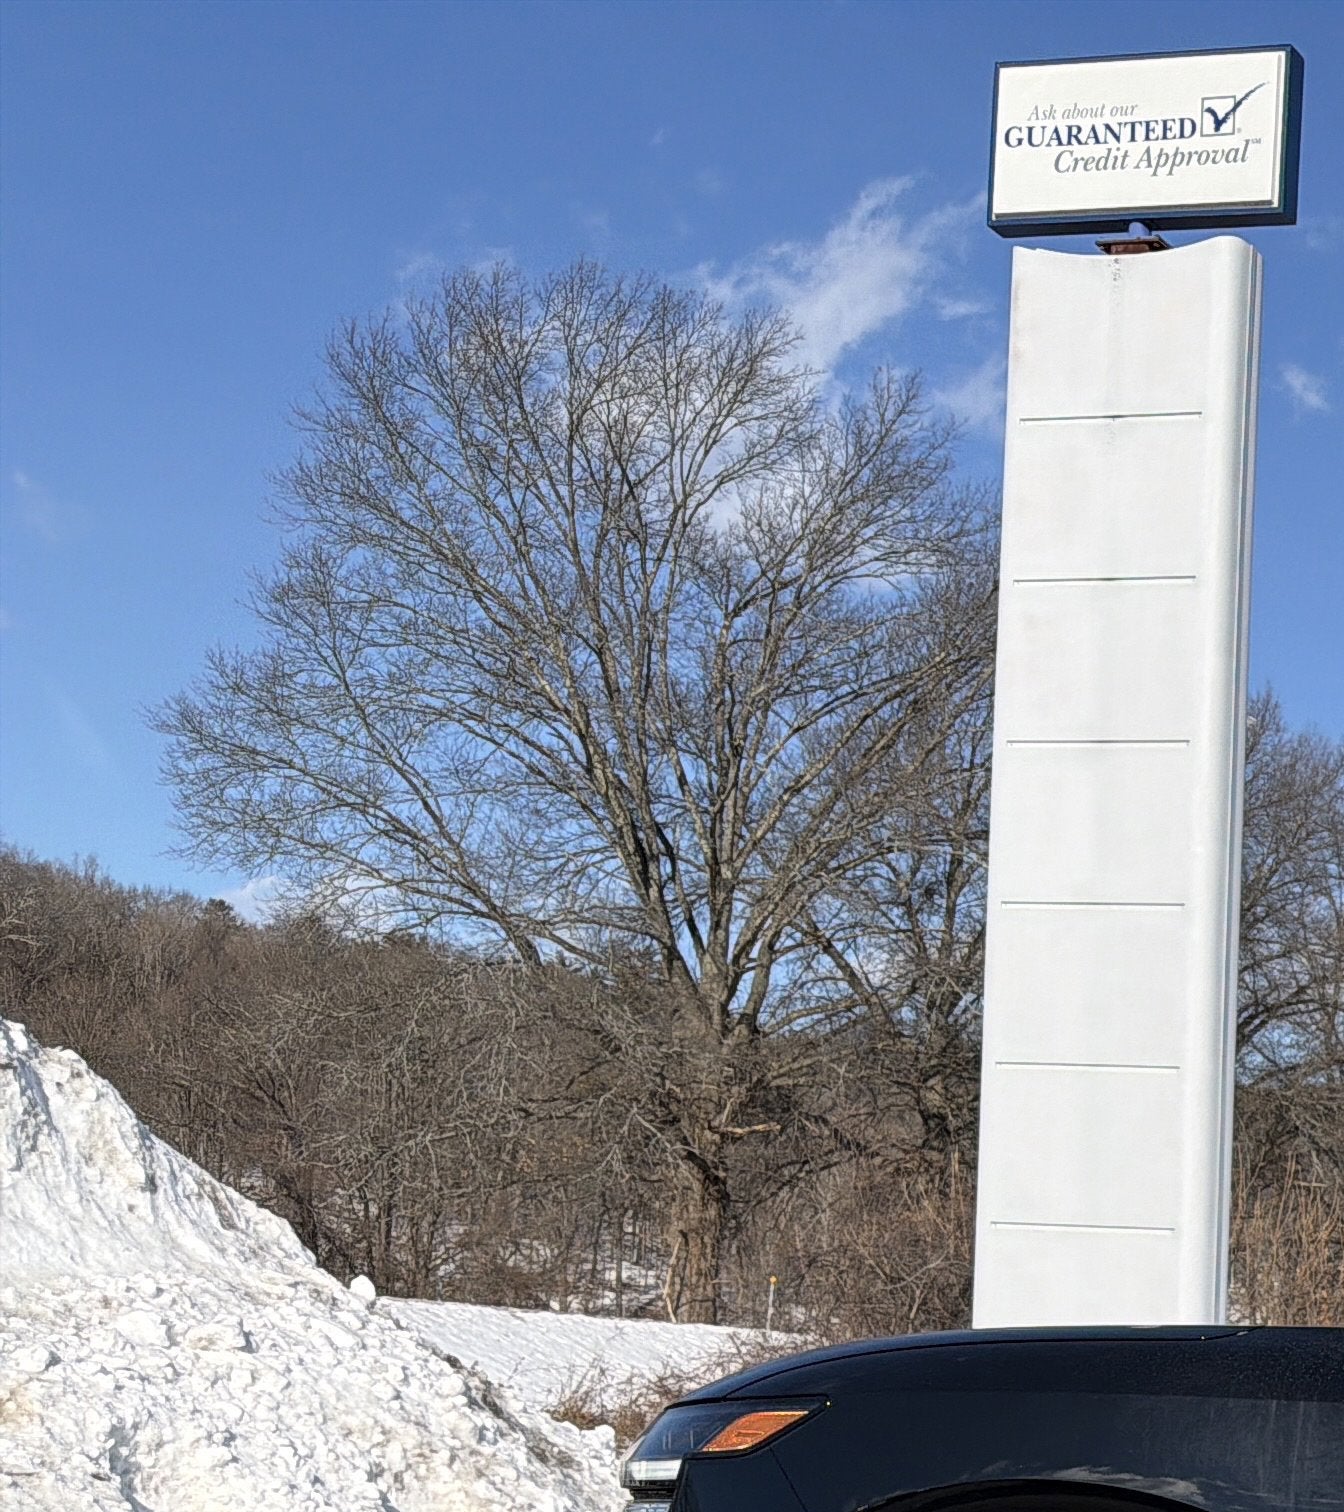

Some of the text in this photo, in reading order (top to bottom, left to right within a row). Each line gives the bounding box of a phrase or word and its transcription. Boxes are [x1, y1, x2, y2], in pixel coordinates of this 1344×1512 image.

[1028, 102, 1138, 121] Ask about our
[1004, 117, 1197, 148] GUARANTEED
[1054, 146, 1130, 173] Credit
[1133, 139, 1250, 177] Approval
